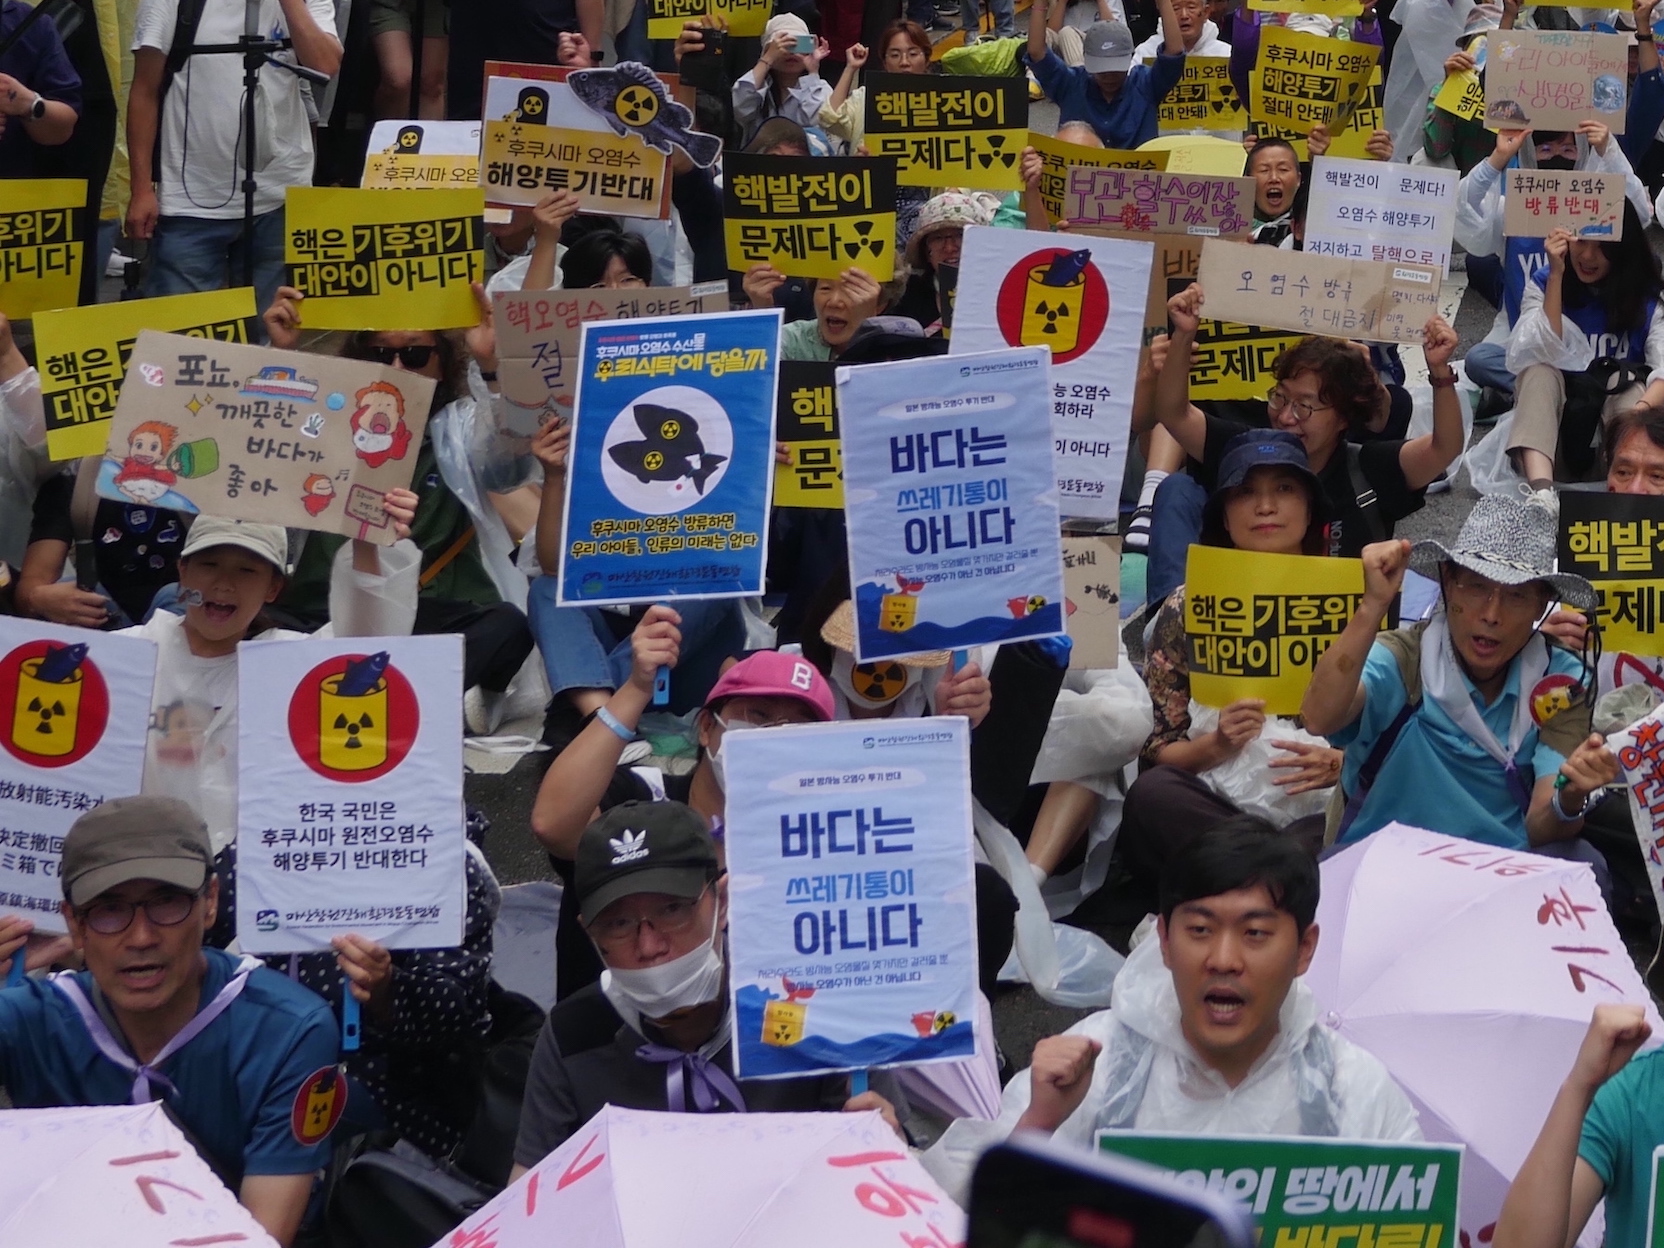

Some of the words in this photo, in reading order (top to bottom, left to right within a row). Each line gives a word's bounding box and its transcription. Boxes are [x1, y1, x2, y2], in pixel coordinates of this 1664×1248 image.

[1265, 44, 1333, 71] 후쿠시마
[1337, 53, 1371, 75] 오염수
[875, 89, 1005, 127] 핵발전이
[486, 160, 655, 202] 해양투기반대
[732, 168, 873, 215] 핵발전이
[1325, 170, 1380, 190] 핵발전이
[1399, 177, 1445, 197] 문제다!
[1513, 173, 1561, 193] 후쿠시마
[1569, 179, 1606, 193] 오염수
[1337, 205, 1378, 222] 오염수
[1382, 209, 1436, 231] 해양투기
[1524, 196, 1600, 216] 방류반대
[292, 227, 347, 261] 핵은
[354, 220, 474, 259] 기후위기
[739, 221, 841, 263] 문제다
[1308, 239, 1363, 259] 저지하고
[292, 262, 379, 296] 대안이
[385, 254, 478, 291] 아니다
[1070, 383, 1111, 400] 오염수
[247, 435, 325, 463] 바다가
[891, 425, 1008, 474] 바다는
[1070, 441, 1111, 457] 아니다
[227, 464, 279, 499] 좋아
[897, 477, 1008, 514] 쓰레기통이
[591, 519, 641, 537] 후쿠시마
[643, 516, 680, 534] 오염수
[683, 514, 734, 533] 방류하면
[905, 505, 1017, 555] 아니다
[572, 541, 596, 558] 우리
[599, 538, 642, 557] 아이들,
[646, 535, 684, 554] 인류의
[687, 533, 726, 551] 미래는
[729, 532, 758, 549] 없다
[792, 662, 813, 689] B
[799, 776, 815, 787] 일본
[843, 774, 866, 785] 오염수
[868, 771, 884, 783] 투기
[885, 771, 902, 782] 반대
[299, 802, 336, 822] 한국
[341, 801, 397, 822] 국민은
[261, 826, 337, 847] 후쿠시마
[342, 824, 434, 846] 원전오염수
[780, 806, 915, 859] 바다는
[273, 851, 347, 872] 해양투기
[354, 850, 428, 870] 반대한다
[611, 849, 649, 865] adidas
[785, 868, 914, 906] 쓰레기통이
[793, 903, 923, 956] 아니다
[1283, 1164, 1438, 1212] 땅에서
